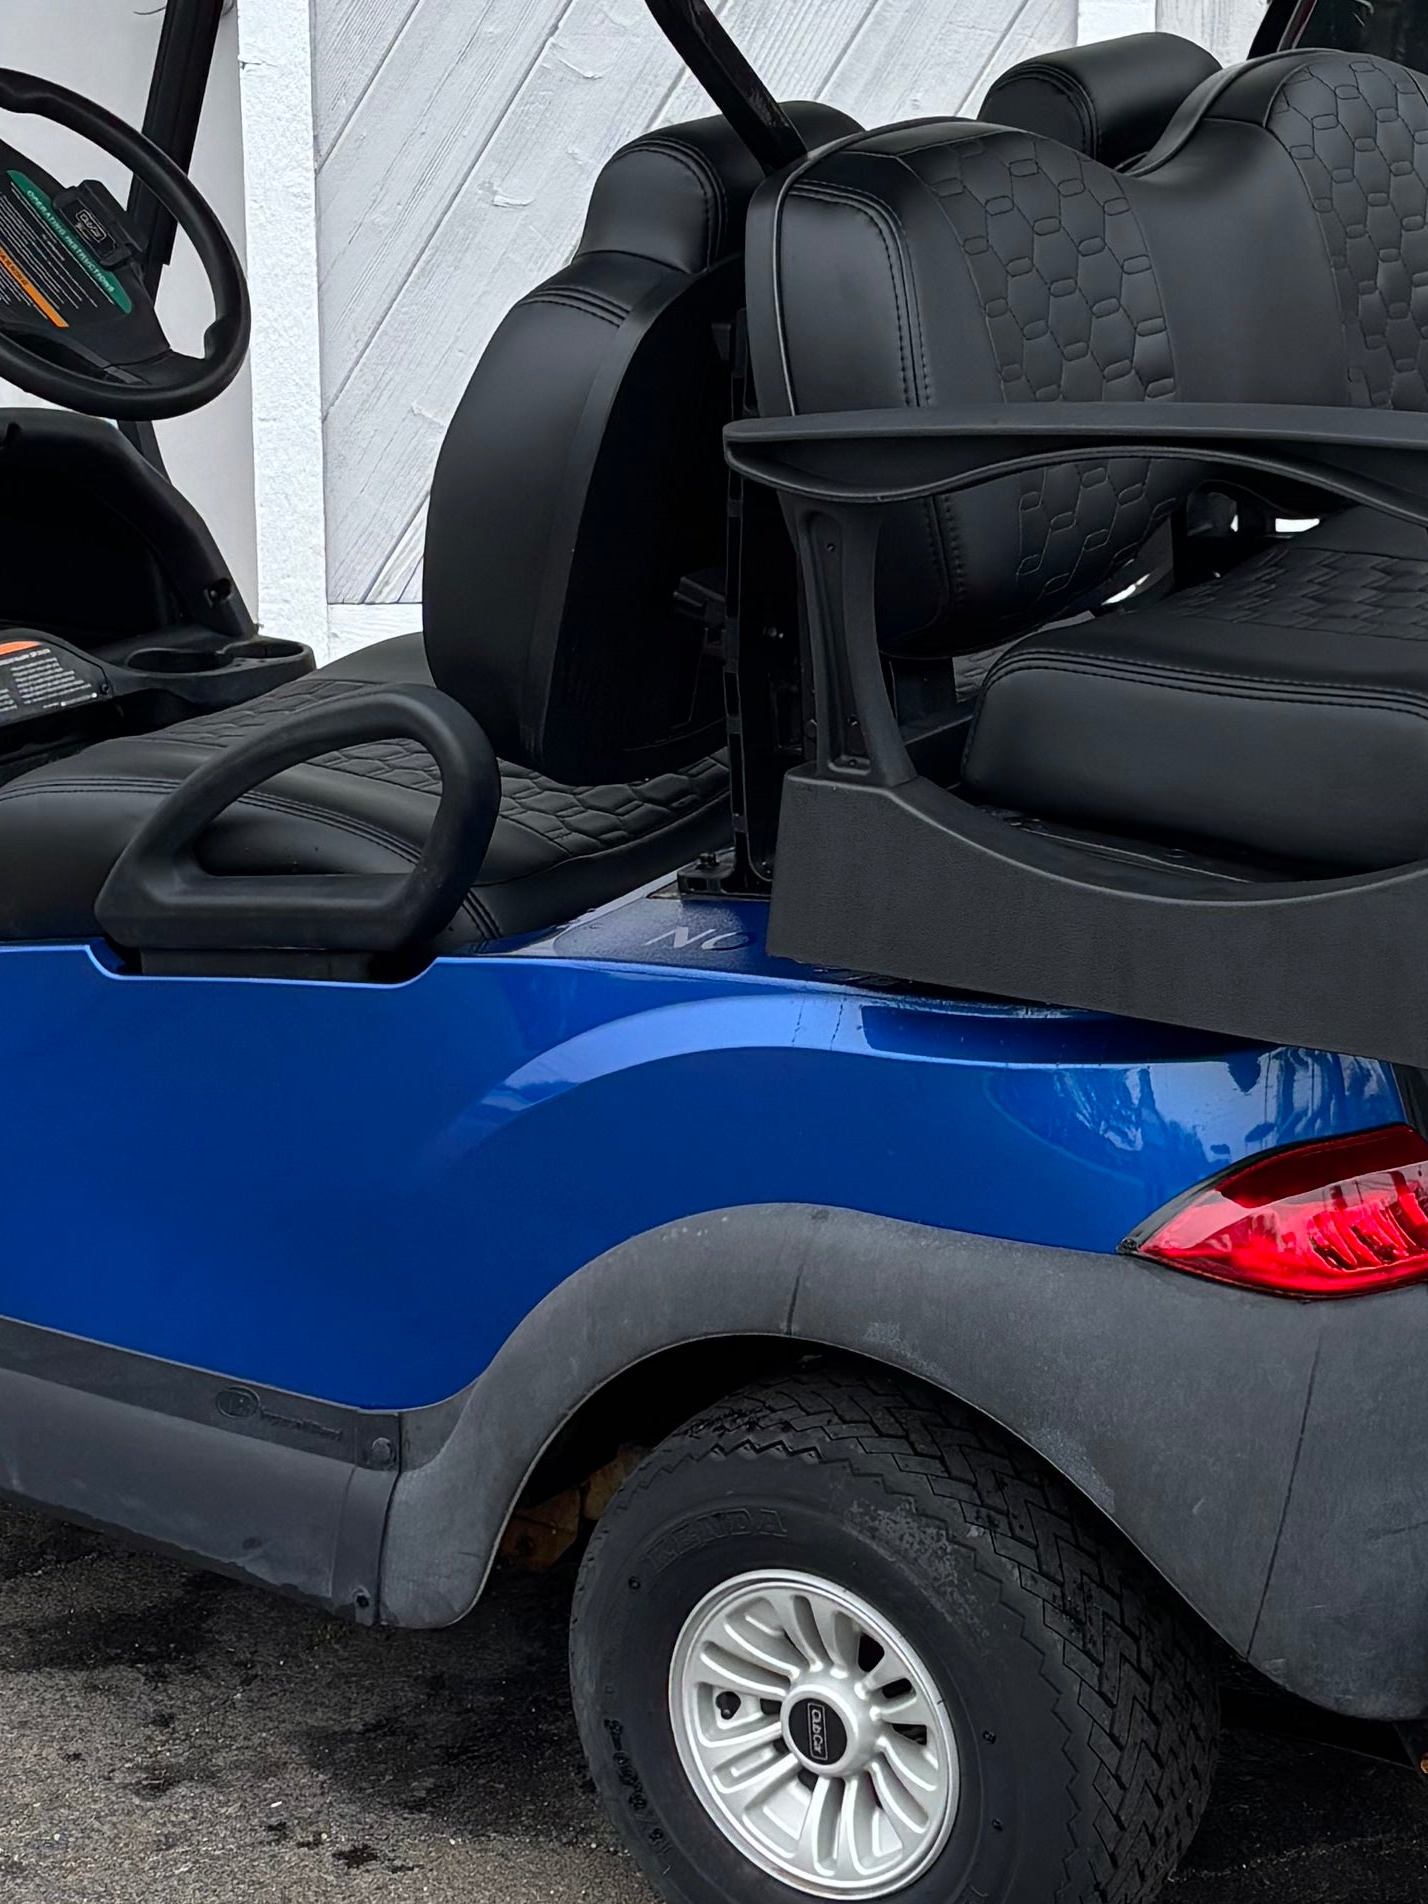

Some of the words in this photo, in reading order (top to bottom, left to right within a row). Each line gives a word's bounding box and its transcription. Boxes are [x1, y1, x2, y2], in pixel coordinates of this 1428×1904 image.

[27, 190, 66, 236] OPERATING
[65, 235, 115, 294] INSTRUCTIONS
[646, 1508, 788, 1574] KENDA
